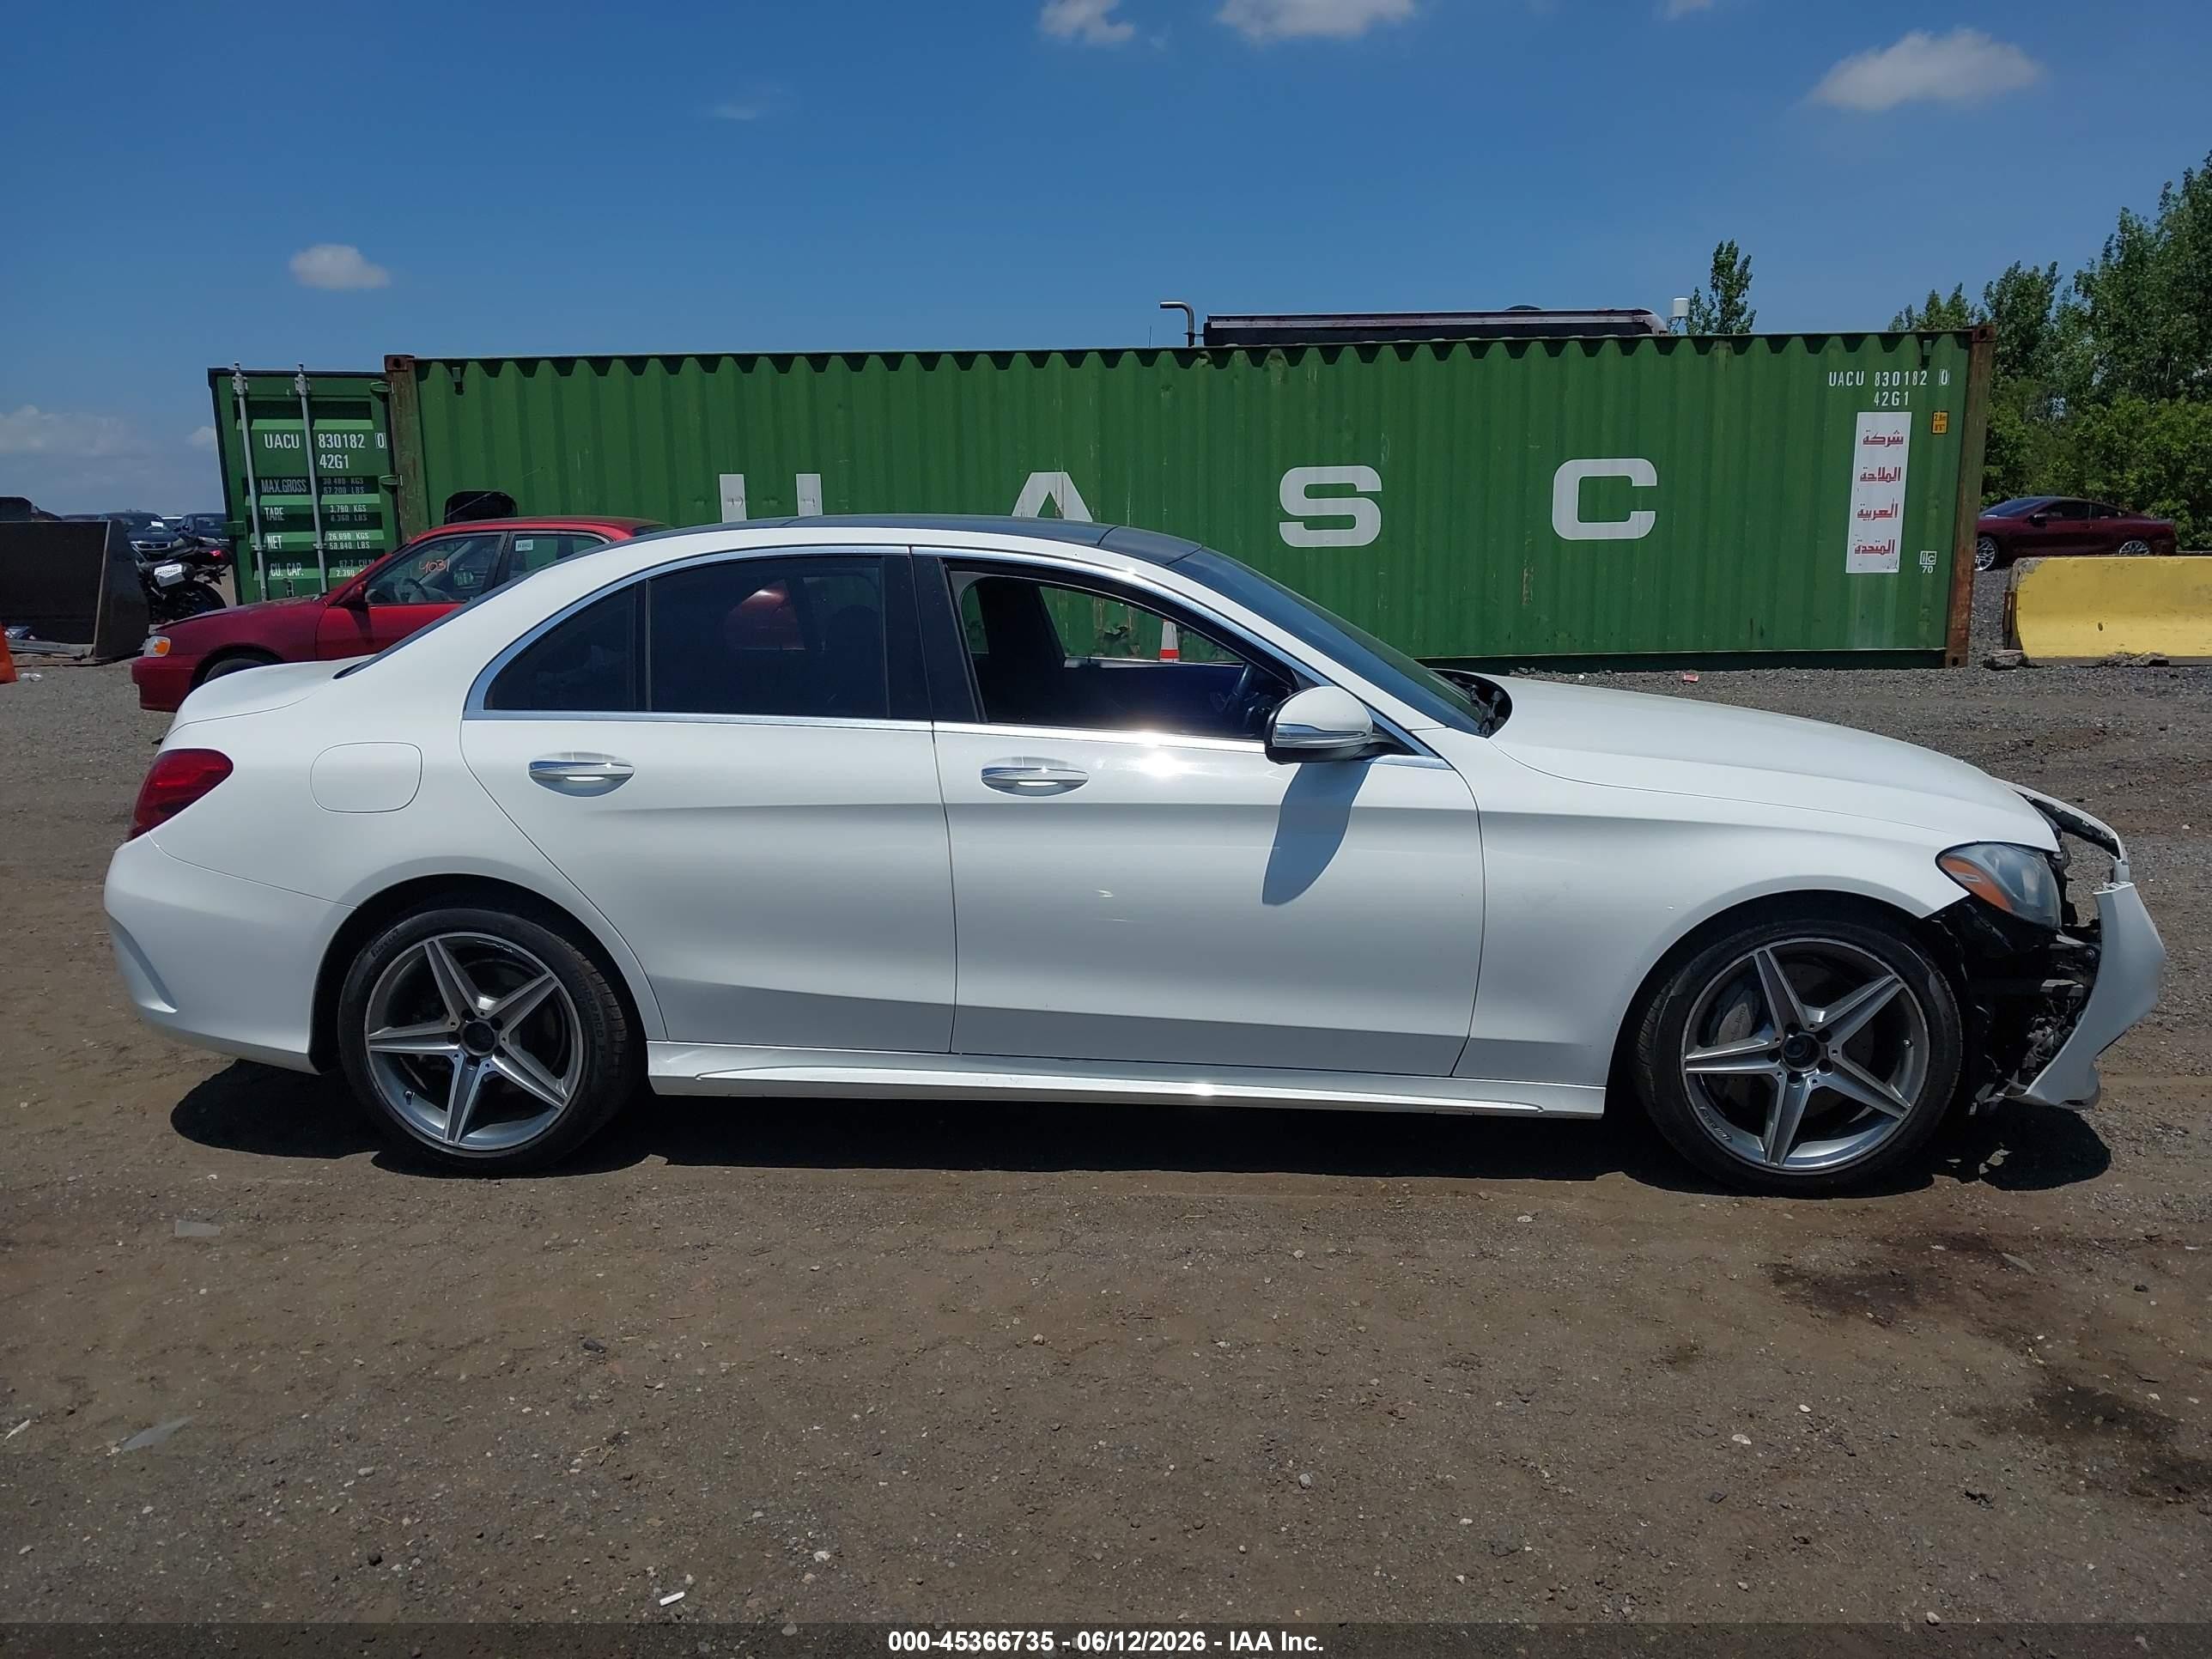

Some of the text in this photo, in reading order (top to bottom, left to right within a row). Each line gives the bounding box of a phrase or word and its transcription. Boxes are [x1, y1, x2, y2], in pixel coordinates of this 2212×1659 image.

[1828, 370, 1865, 386] UACU
[1875, 370, 1928, 386] 830182
[1874, 391, 1910, 406] 42G1
[264, 434, 300, 448] UACU
[318, 433, 365, 448] 830182
[1863, 429, 1904, 447] شركة
[319, 454, 349, 469] 42G1
[1859, 466, 1901, 483] الملاحة
[264, 507, 285, 521] TARE
[1856, 497, 1899, 521] العربية
[266, 535, 283, 550] NET
[1854, 538, 1895, 556] المتحدة
[287, 562, 304, 576] CAP.
[1922, 565, 1934, 574] 70
